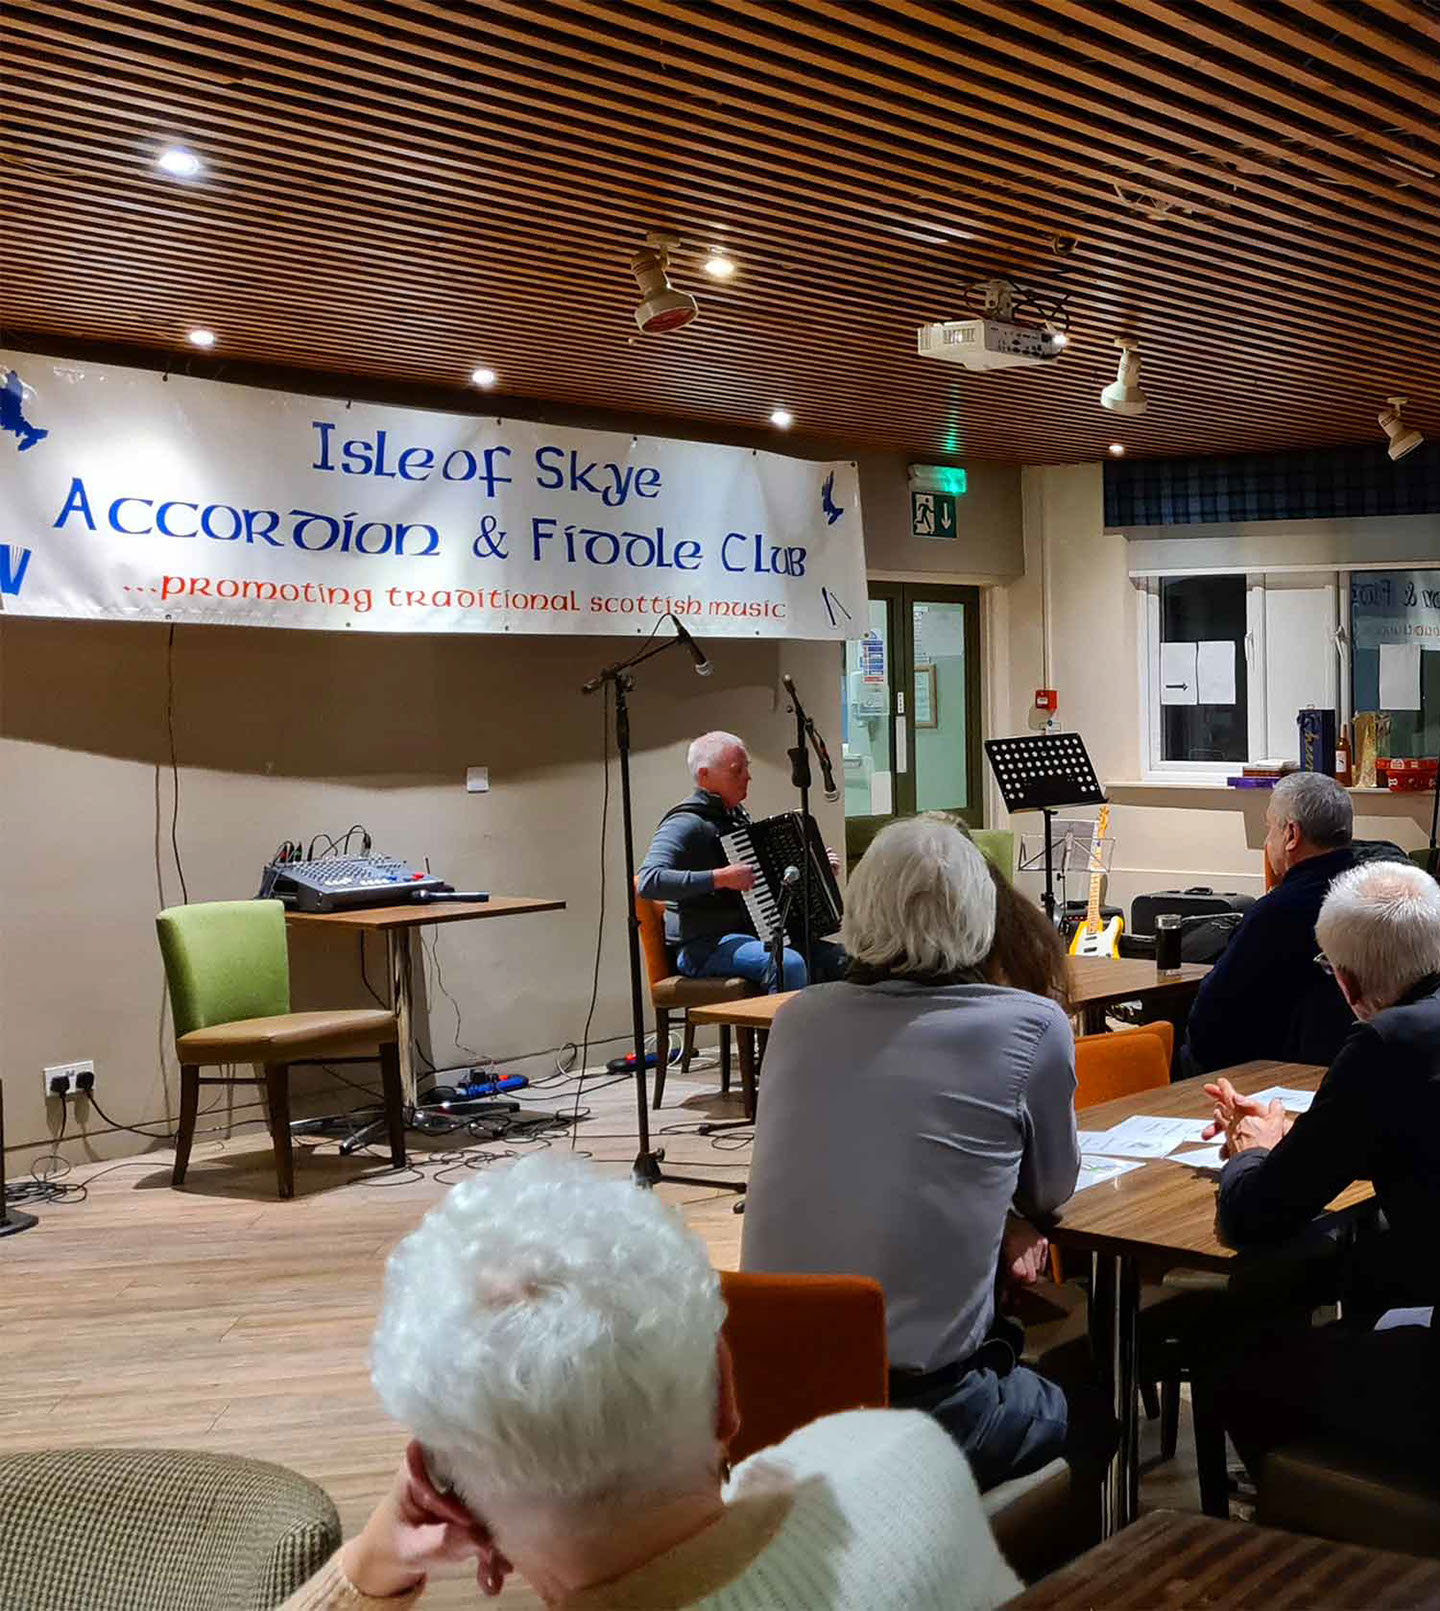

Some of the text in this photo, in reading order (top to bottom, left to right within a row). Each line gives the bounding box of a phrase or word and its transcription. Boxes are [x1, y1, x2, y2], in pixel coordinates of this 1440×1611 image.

[312, 421, 662, 507] Isle of Skye
[53, 477, 807, 577] Accordion & Fiddle Club
[386, 587, 581, 612] traditional
[590, 596, 701, 615] scottish
[708, 601, 786, 618] music
